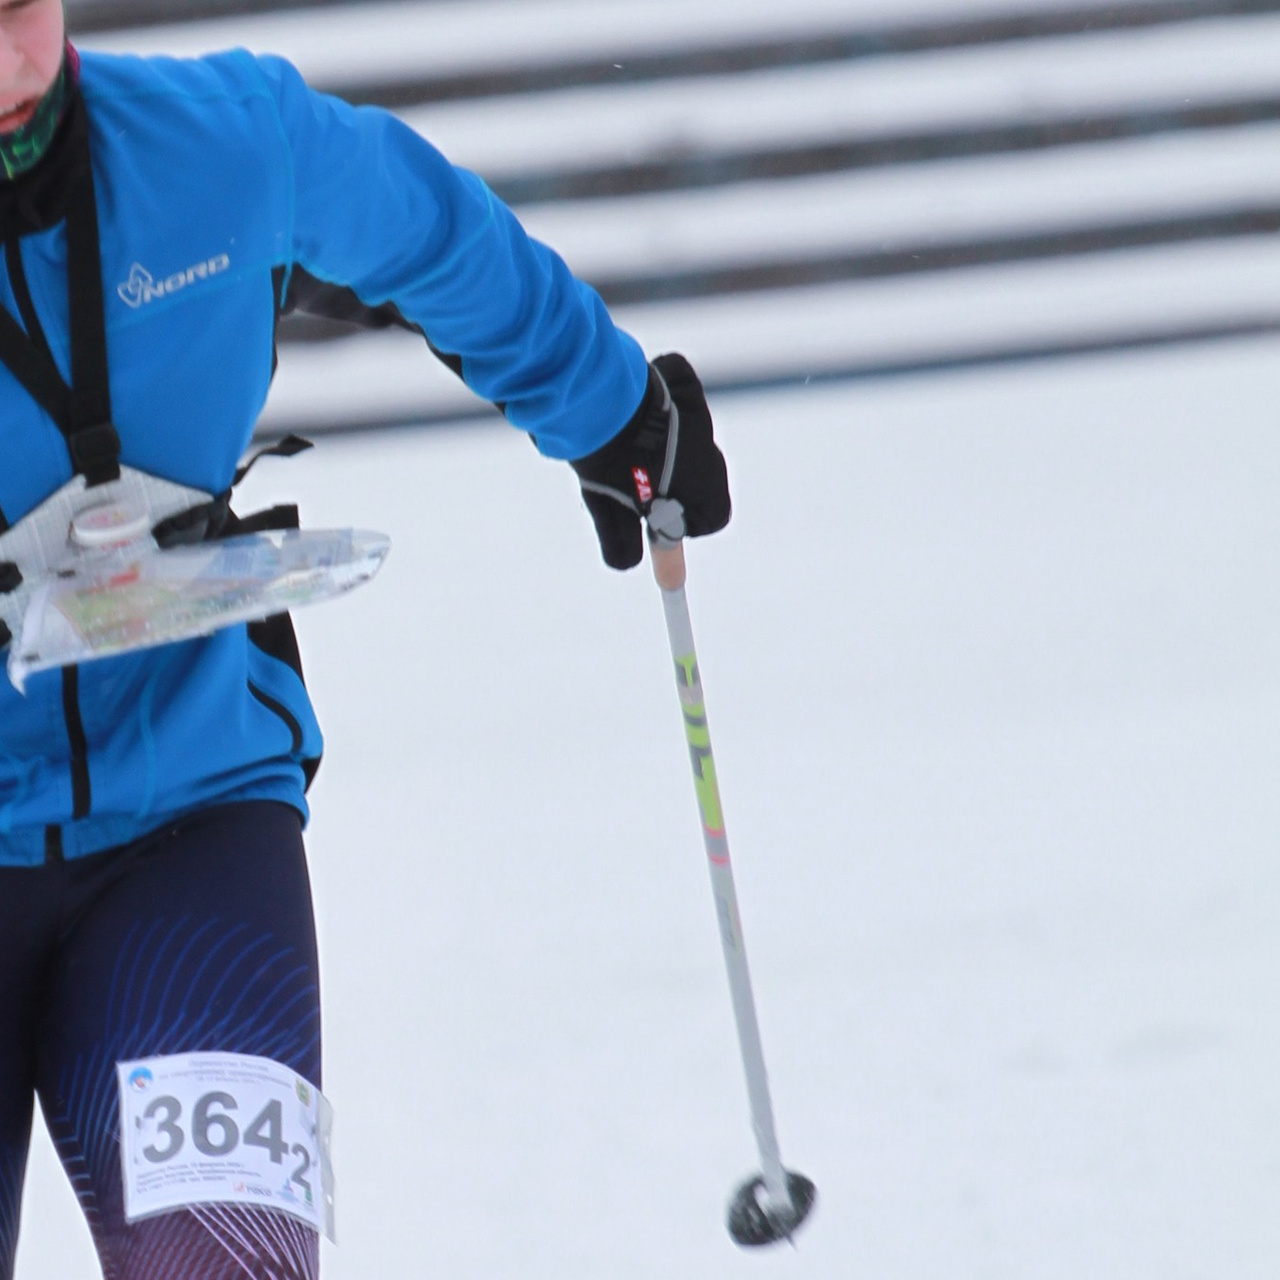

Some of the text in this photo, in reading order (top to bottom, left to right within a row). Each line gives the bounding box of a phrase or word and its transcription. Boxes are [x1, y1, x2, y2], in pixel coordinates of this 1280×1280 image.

[144, 253, 230, 302] NORD
[143, 1090, 313, 1207] 364 2
